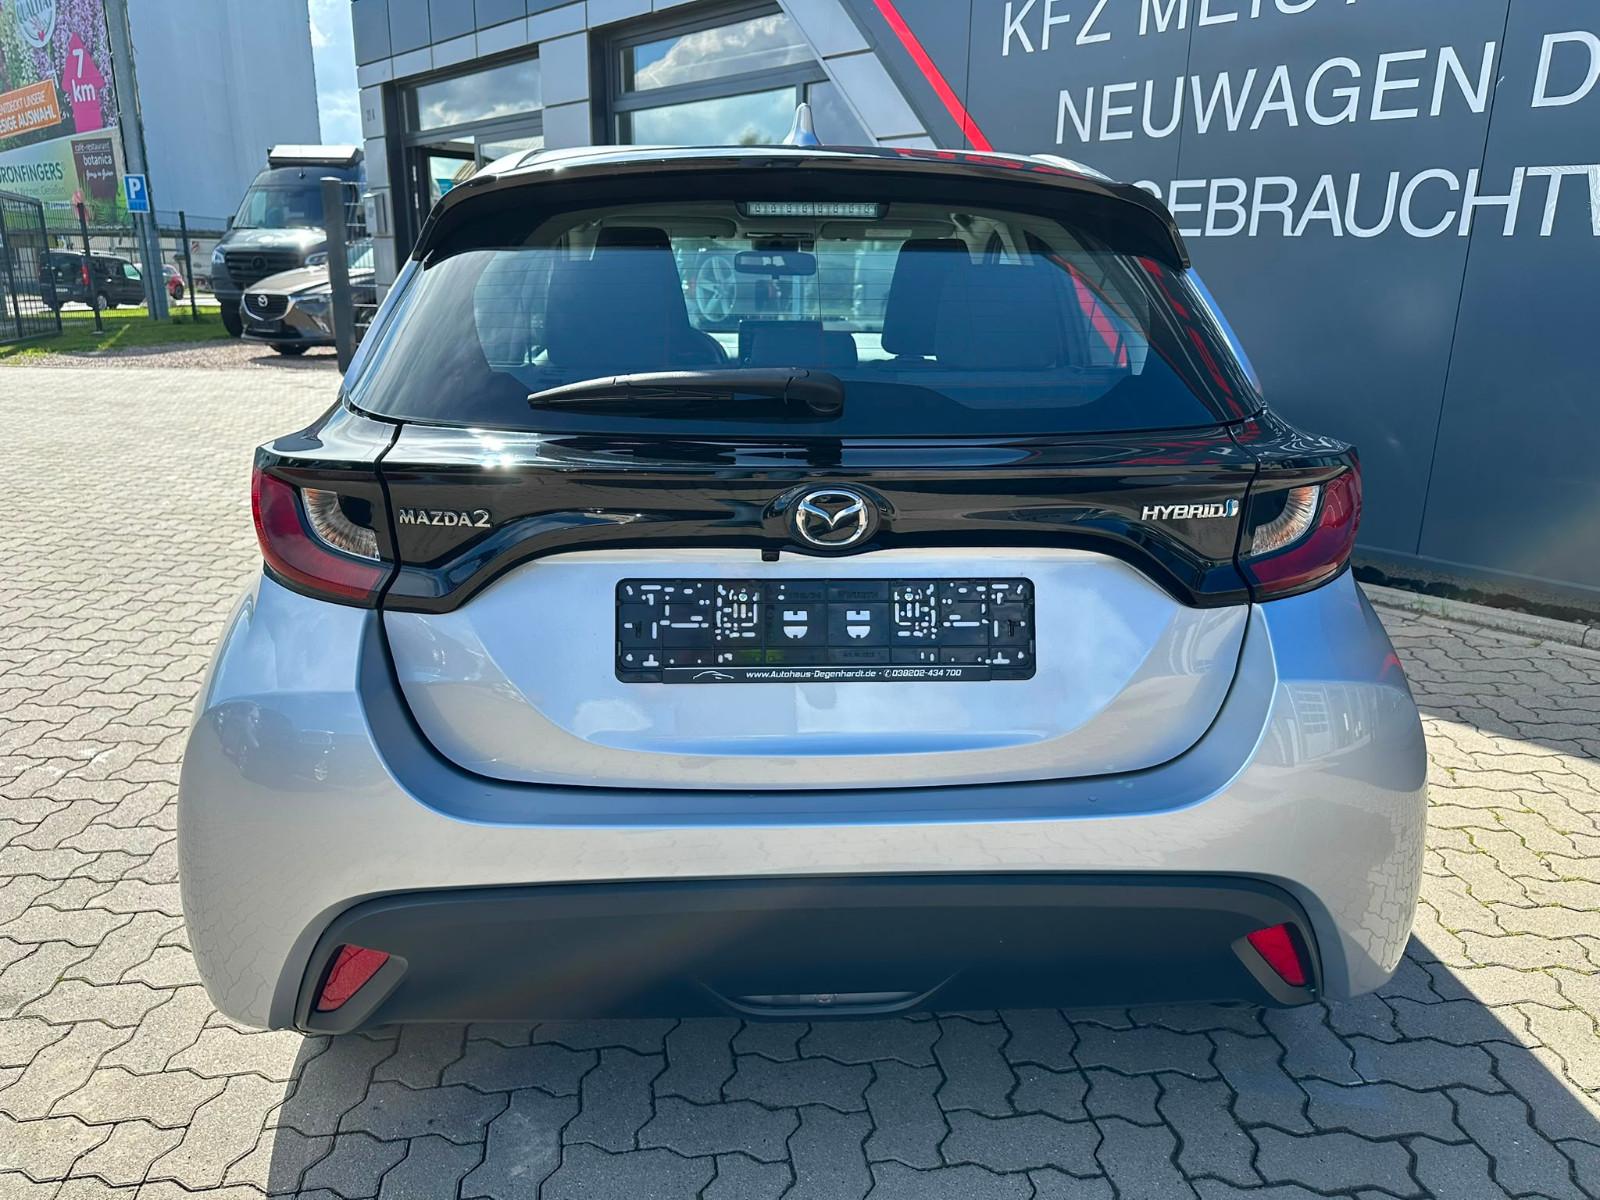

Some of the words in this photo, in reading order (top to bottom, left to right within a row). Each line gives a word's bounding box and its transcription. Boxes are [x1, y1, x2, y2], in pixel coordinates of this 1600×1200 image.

[1002, 0, 1112, 56] KFZ
[73, 48, 85, 79] 7
[72, 79, 96, 103] km
[1056, 41, 1496, 145] NEUWAGEN
[83, 153, 113, 166] botanica
[0, 162, 63, 184] RONFINGERS
[128, 178, 142, 199] P
[1133, 164, 1600, 238] EBRAUCHT
[399, 508, 491, 529] MAZDA2
[1141, 503, 1227, 521] HYBRID
[745, 669, 877, 680] www.Autohaus-Degenhardt.de
[944, 668, 962, 678] 700
